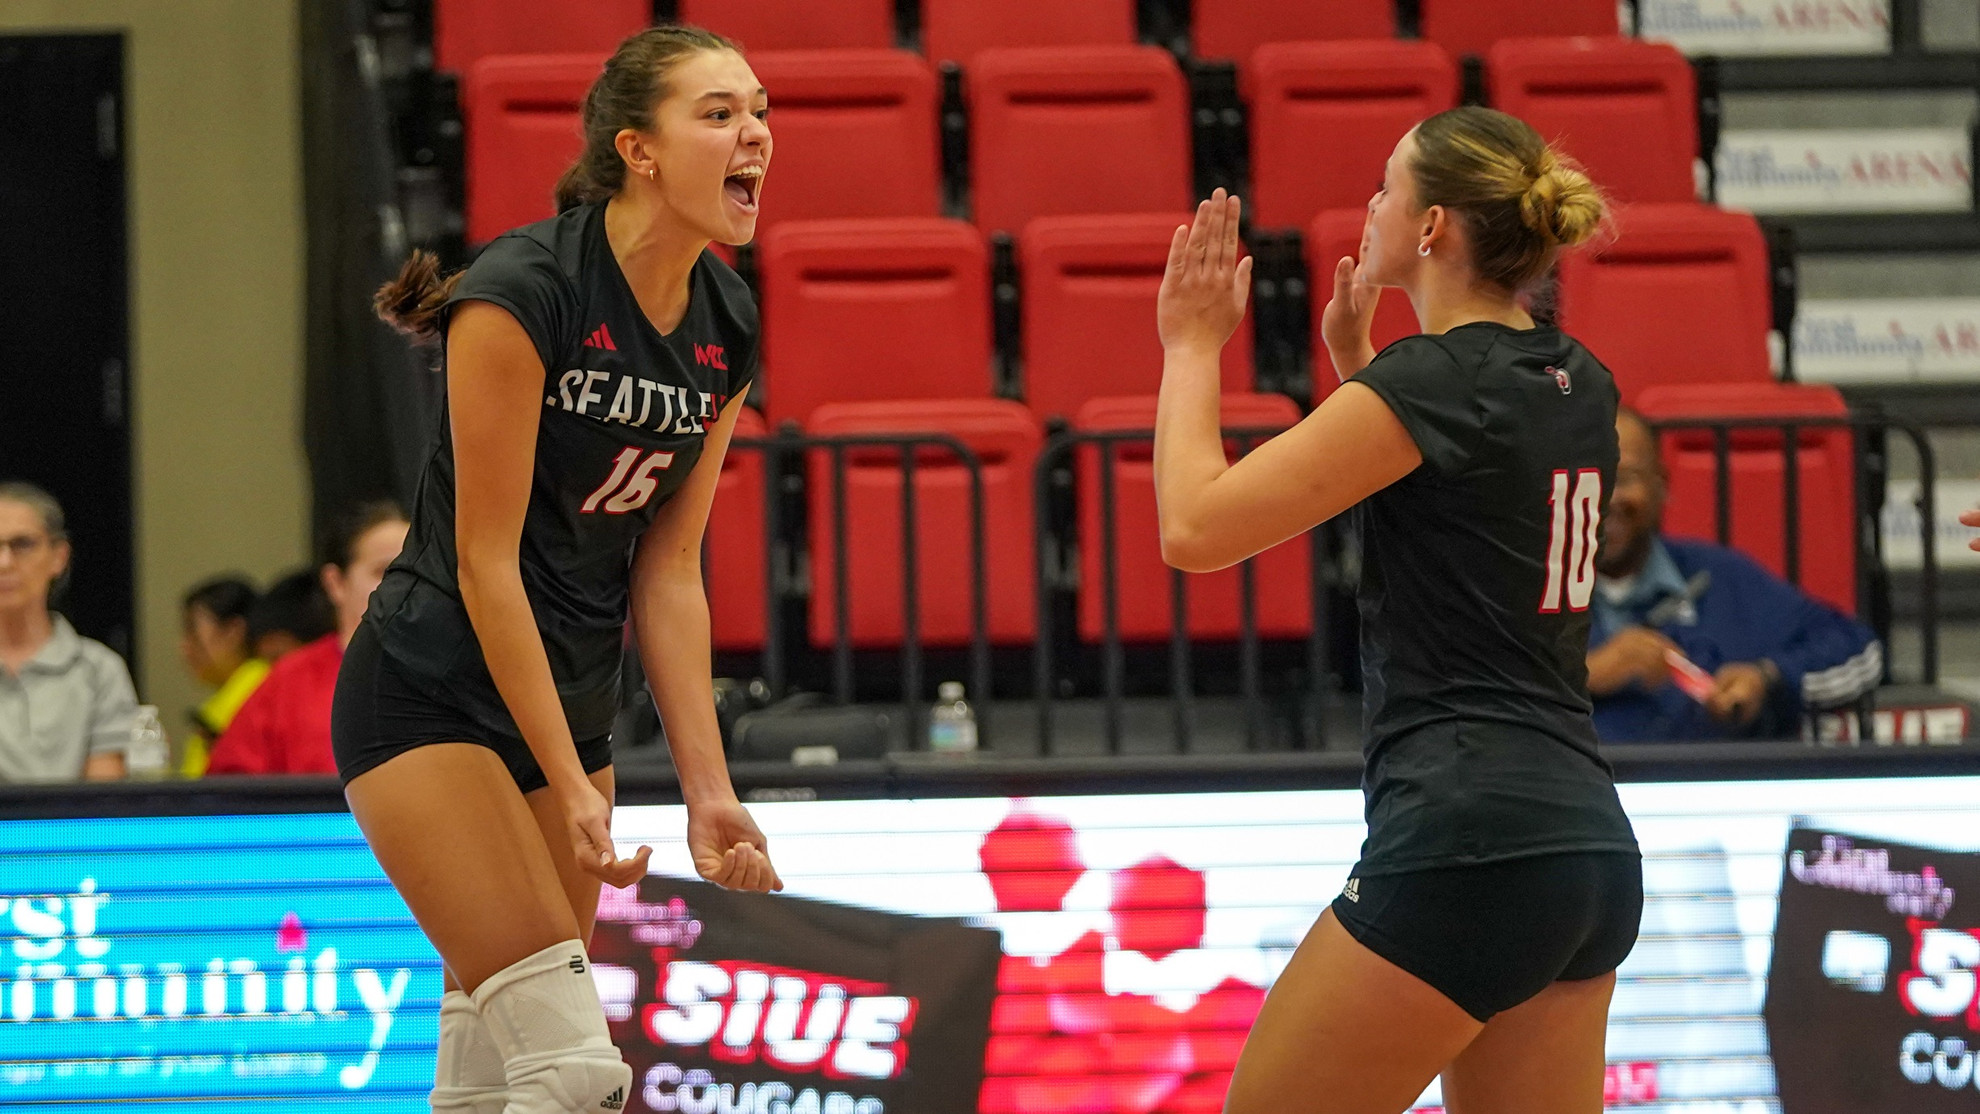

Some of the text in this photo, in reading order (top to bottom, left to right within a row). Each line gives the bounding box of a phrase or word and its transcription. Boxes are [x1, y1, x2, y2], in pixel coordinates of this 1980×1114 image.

[579, 445, 676, 515] 16
[1538, 467, 1602, 614] 10
[0, 946, 412, 1090] munity
[648, 959, 914, 1081] SIUE
[1903, 926, 1980, 1018] S
[1900, 1031, 1980, 1092] CO
